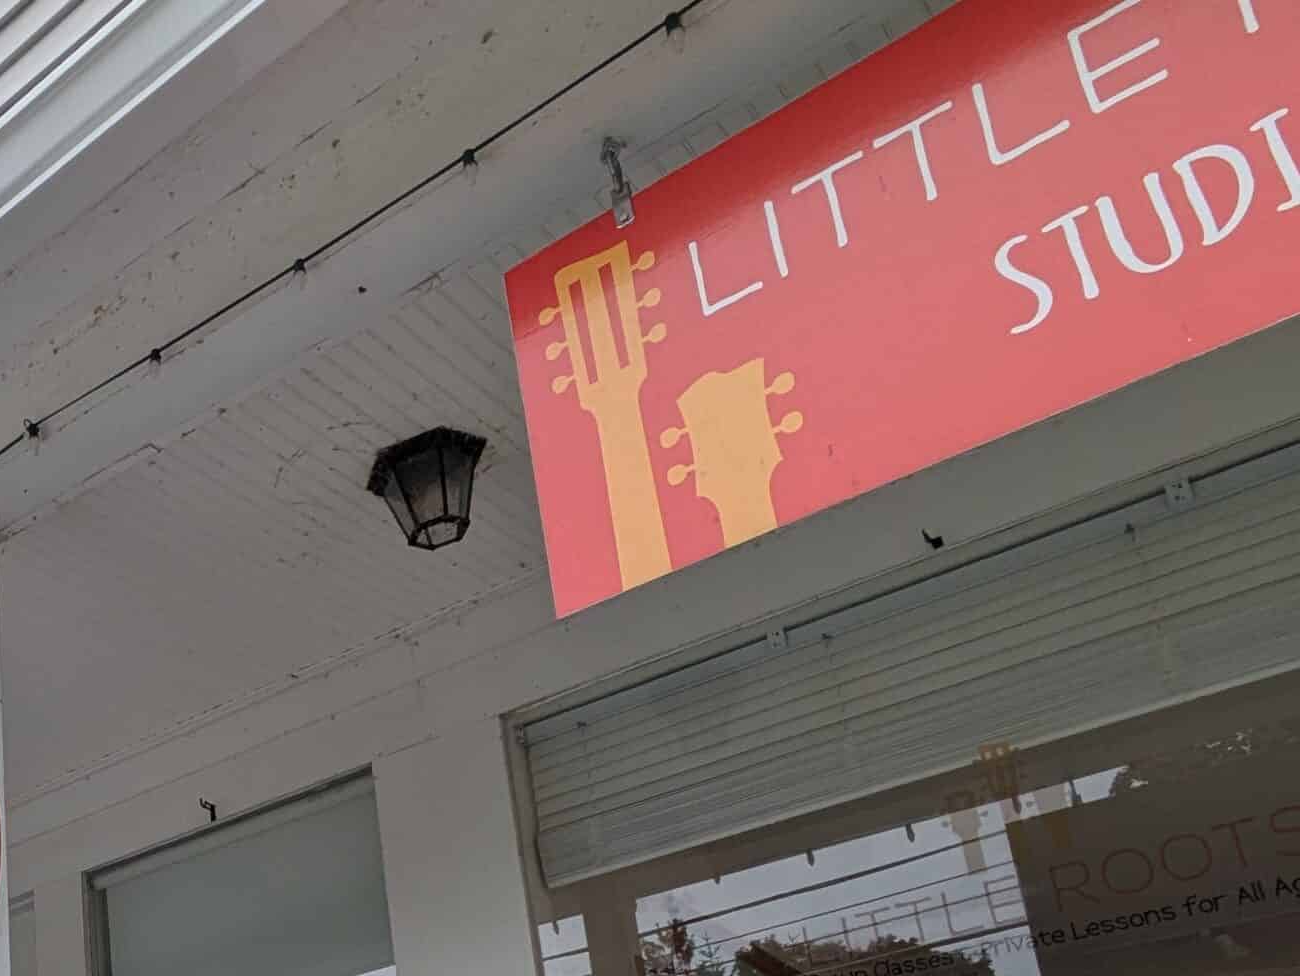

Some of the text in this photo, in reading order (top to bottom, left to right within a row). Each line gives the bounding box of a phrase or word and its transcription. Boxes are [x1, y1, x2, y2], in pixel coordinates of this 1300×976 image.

[688, 0, 1169, 317] LITTLE
[802, 874, 1029, 969] LITTLE
[1070, 904, 1177, 941] Lessons
[1182, 894, 1227, 917] for
[1238, 880, 1267, 905] All
